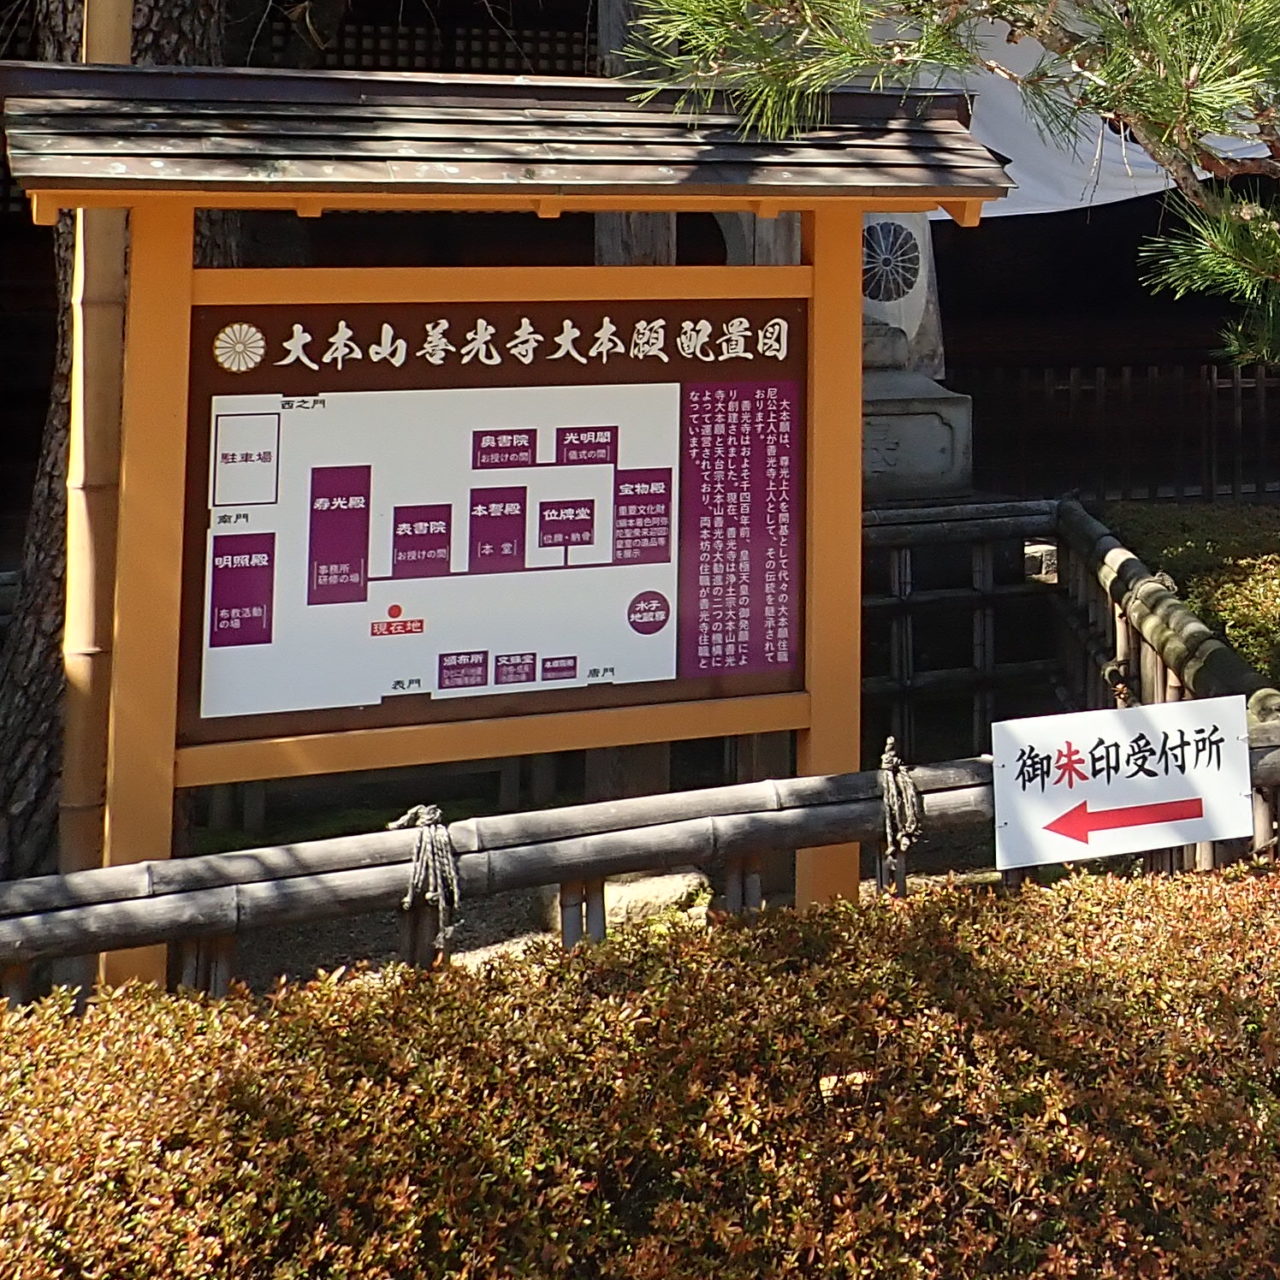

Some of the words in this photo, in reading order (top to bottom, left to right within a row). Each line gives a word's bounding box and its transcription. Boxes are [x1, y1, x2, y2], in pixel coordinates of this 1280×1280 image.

[272, 317, 790, 371] 大本山善光寺大本願配置図
[280, 399, 326, 410] 西之門
[754, 389, 766, 440] おります。
[688, 391, 701, 465] なっています。
[220, 451, 273, 465] 駐車場
[618, 481, 666, 496] 宝物殿
[543, 507, 591, 521] 位牌堂
[396, 521, 447, 536] 表書院
[214, 553, 269, 569] 明照殿
[635, 600, 661, 612] 水子
[372, 621, 422, 635] 現在地
[391, 678, 421, 690] 表門
[1014, 724, 1226, 793] 御朱印受付所
